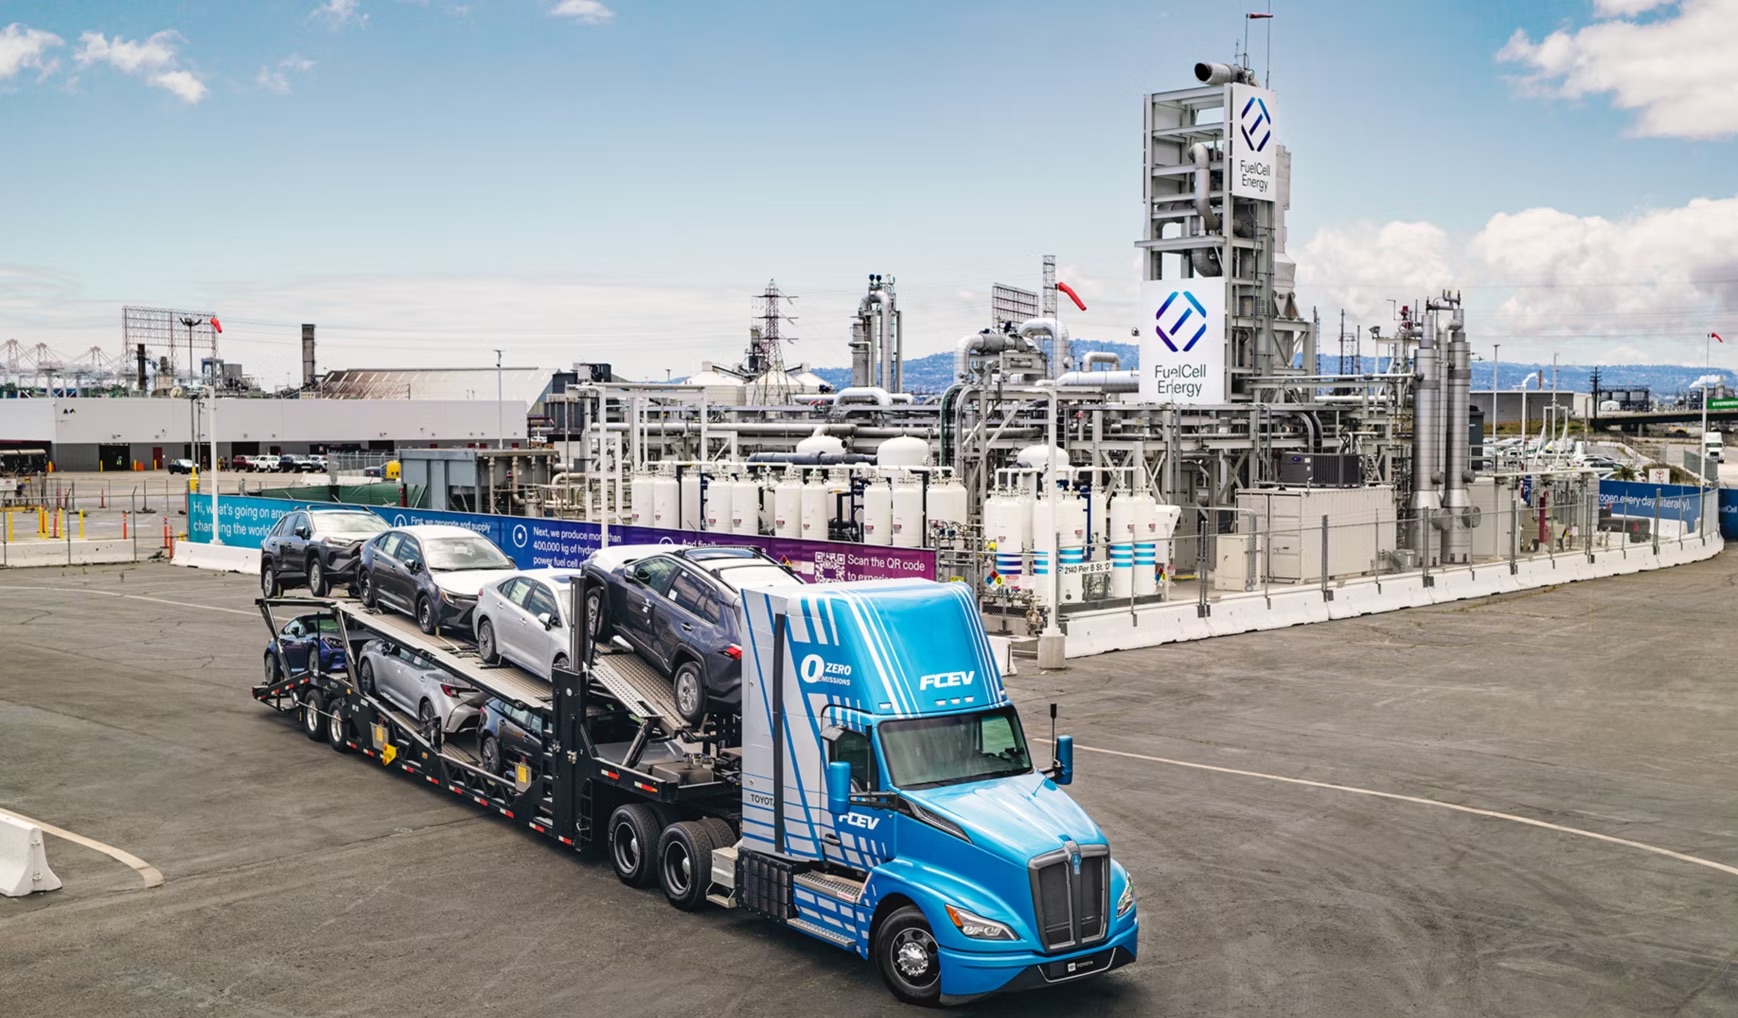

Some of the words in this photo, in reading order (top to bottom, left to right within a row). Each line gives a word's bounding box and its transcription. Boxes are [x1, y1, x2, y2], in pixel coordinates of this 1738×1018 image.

[1240, 159, 1271, 177] FuelCell
[1241, 173, 1269, 193] Energy
[1154, 363, 1207, 379] FuelCell
[1157, 379, 1203, 398] Energy
[1600, 494, 1618, 505] ogen
[193, 501, 205, 516] Hi,
[206, 503, 233, 517] wat's
[234, 505, 258, 520] going
[259, 508, 270, 518] on
[271, 509, 289, 519] aro
[193, 520, 232, 537] chaning
[233, 522, 247, 535] the
[472, 523, 491, 534] supply
[533, 526, 550, 538] Next,
[551, 530, 560, 538] we
[561, 530, 587, 540] produce
[589, 533, 609, 542] mor
[533, 541, 560, 552] 400,000
[561, 543, 569, 555] kg
[570, 545, 577, 553] of
[533, 556, 553, 566] power
[554, 557, 566, 566] fuel
[567, 559, 578, 568] cell
[848, 554, 869, 566] Scan
[871, 555, 885, 568] the
[886, 557, 901, 569] QR
[903, 561, 926, 572] code
[1079, 565, 1089, 573] Pier
[848, 572, 856, 581] to
[800, 653, 825, 683] 0
[825, 662, 852, 676] ZERO
[920, 670, 975, 691] FCEV
